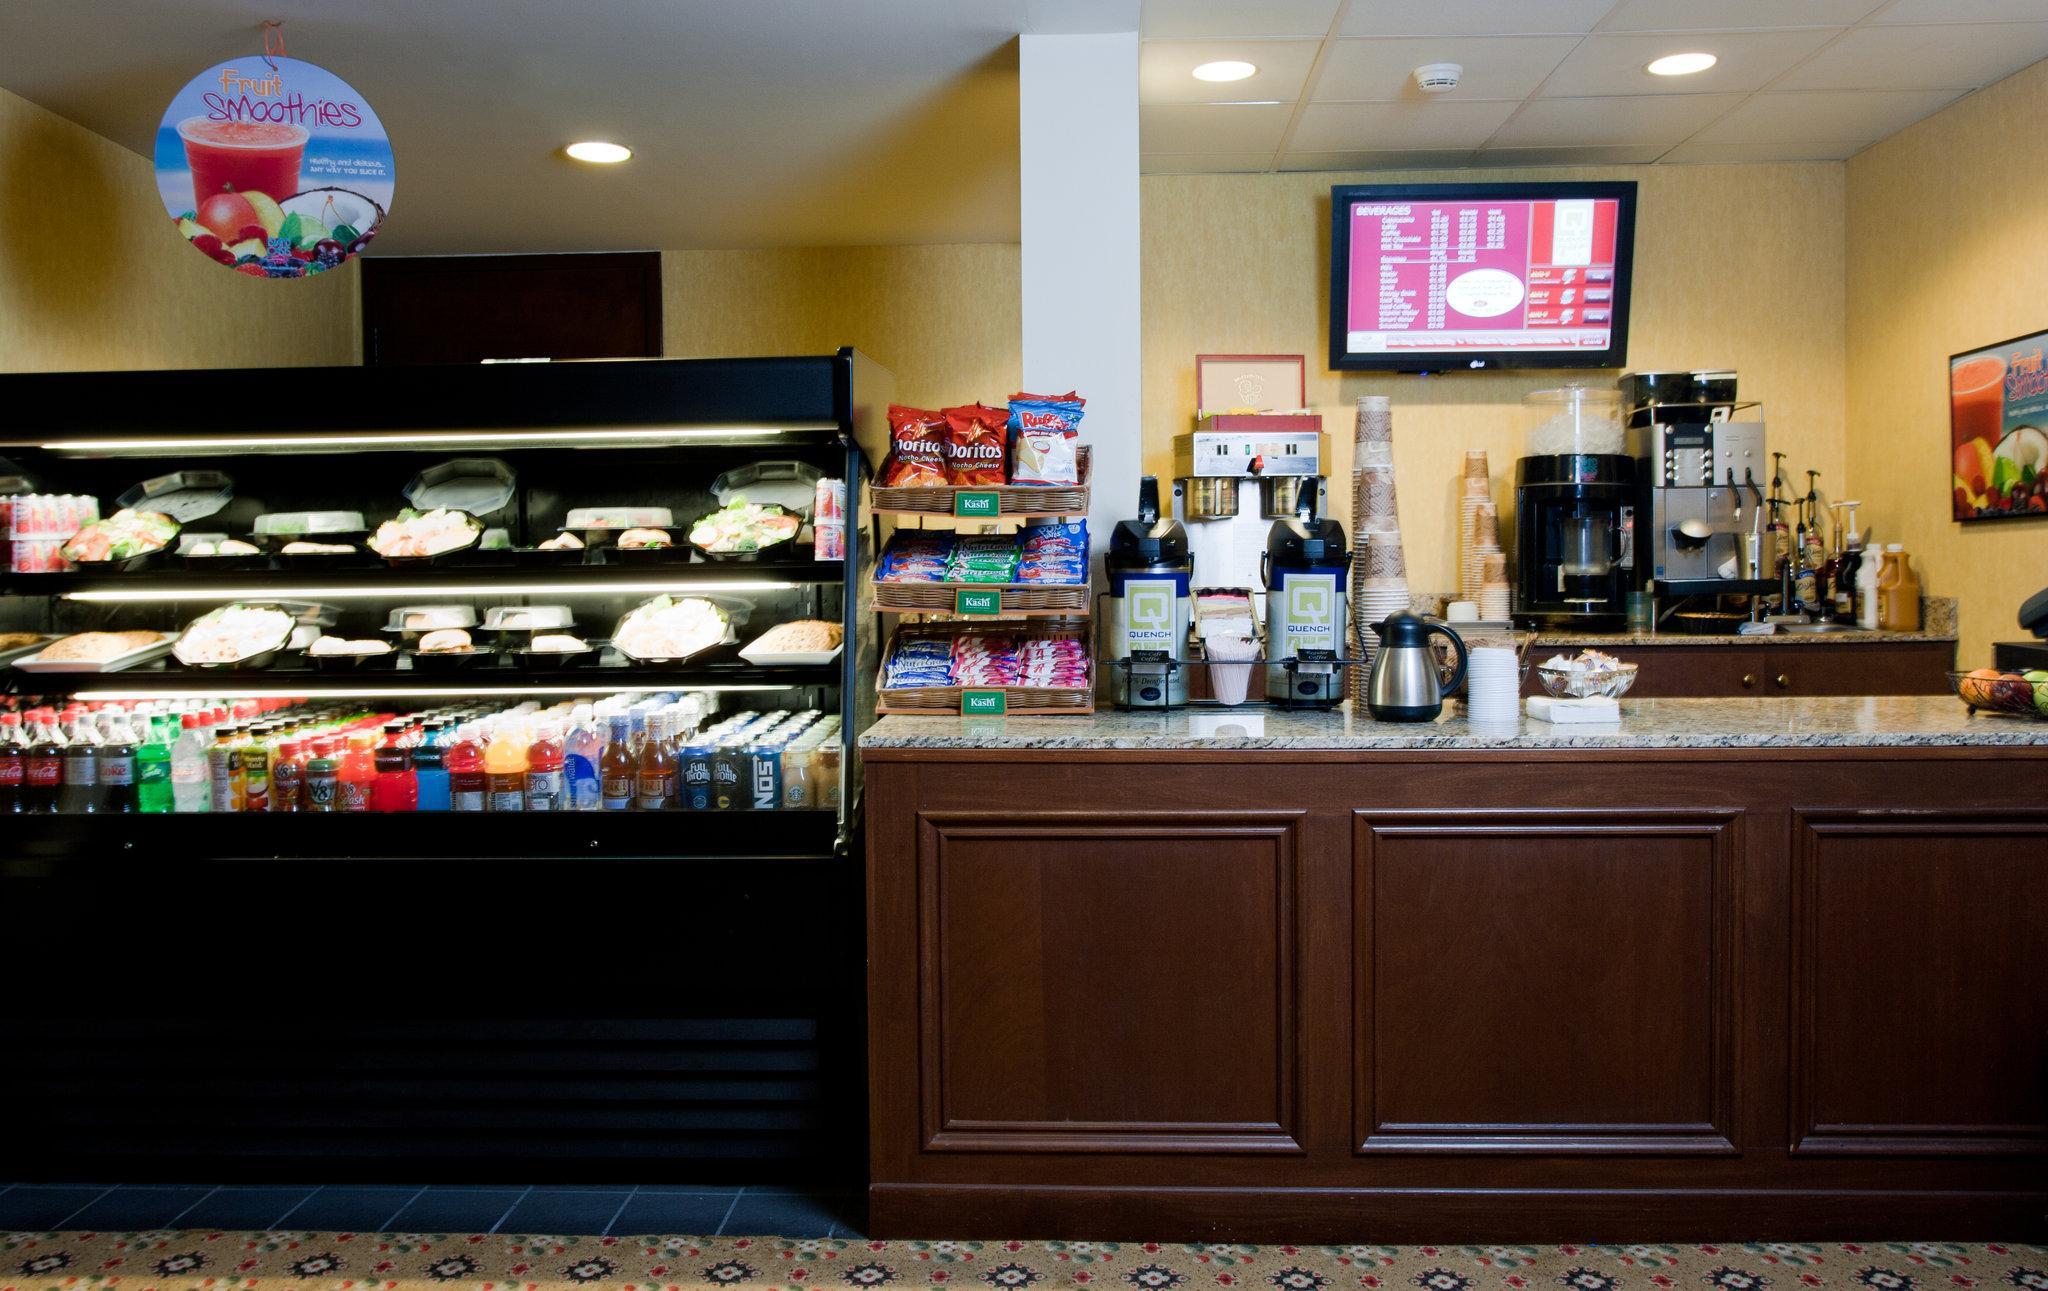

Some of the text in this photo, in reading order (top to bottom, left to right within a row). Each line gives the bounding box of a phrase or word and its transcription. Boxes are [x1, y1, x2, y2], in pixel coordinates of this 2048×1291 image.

[219, 69, 283, 97] Fruit
[1356, 205, 1411, 216] BEVERAGES
[948, 442, 1002, 459] Doritos
[964, 499, 990, 509] Kashi
[965, 597, 991, 608] Kashi
[1287, 625, 1330, 633] QUENCH
[1128, 631, 1172, 639] QUENCH
[970, 697, 996, 707] Kashi
[277, 765, 289, 778] V8
[690, 762, 706, 773] Full
[715, 762, 730, 772] Full
[752, 755, 774, 809] NOS
[309, 780, 328, 801] V8
